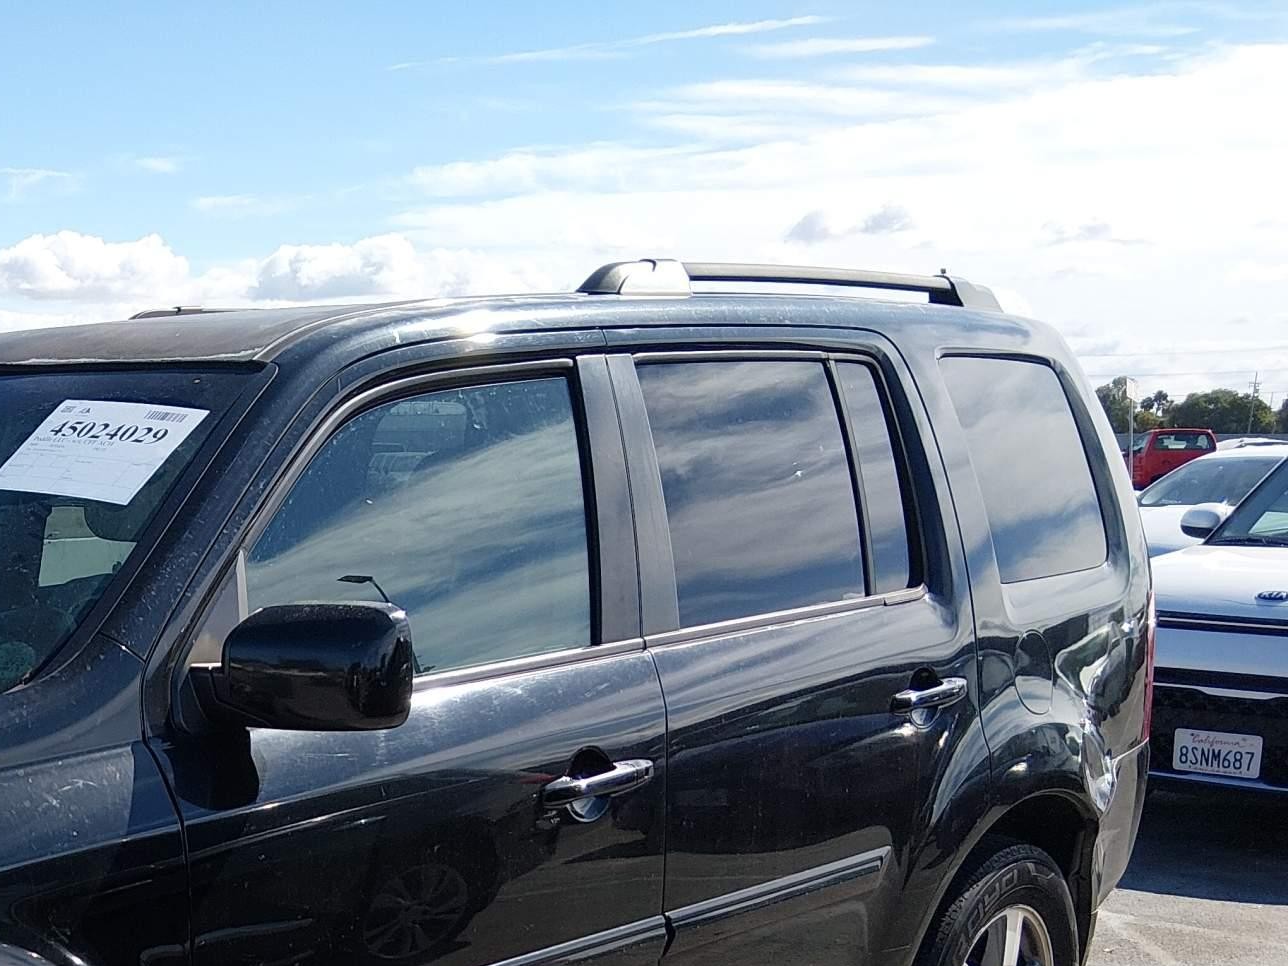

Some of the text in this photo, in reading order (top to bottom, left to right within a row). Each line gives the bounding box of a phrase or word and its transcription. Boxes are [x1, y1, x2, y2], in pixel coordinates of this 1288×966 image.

[50, 420, 169, 445] 45024029
[1191, 735, 1244, 748] California
[1178, 745, 1255, 772] 8SNM687
